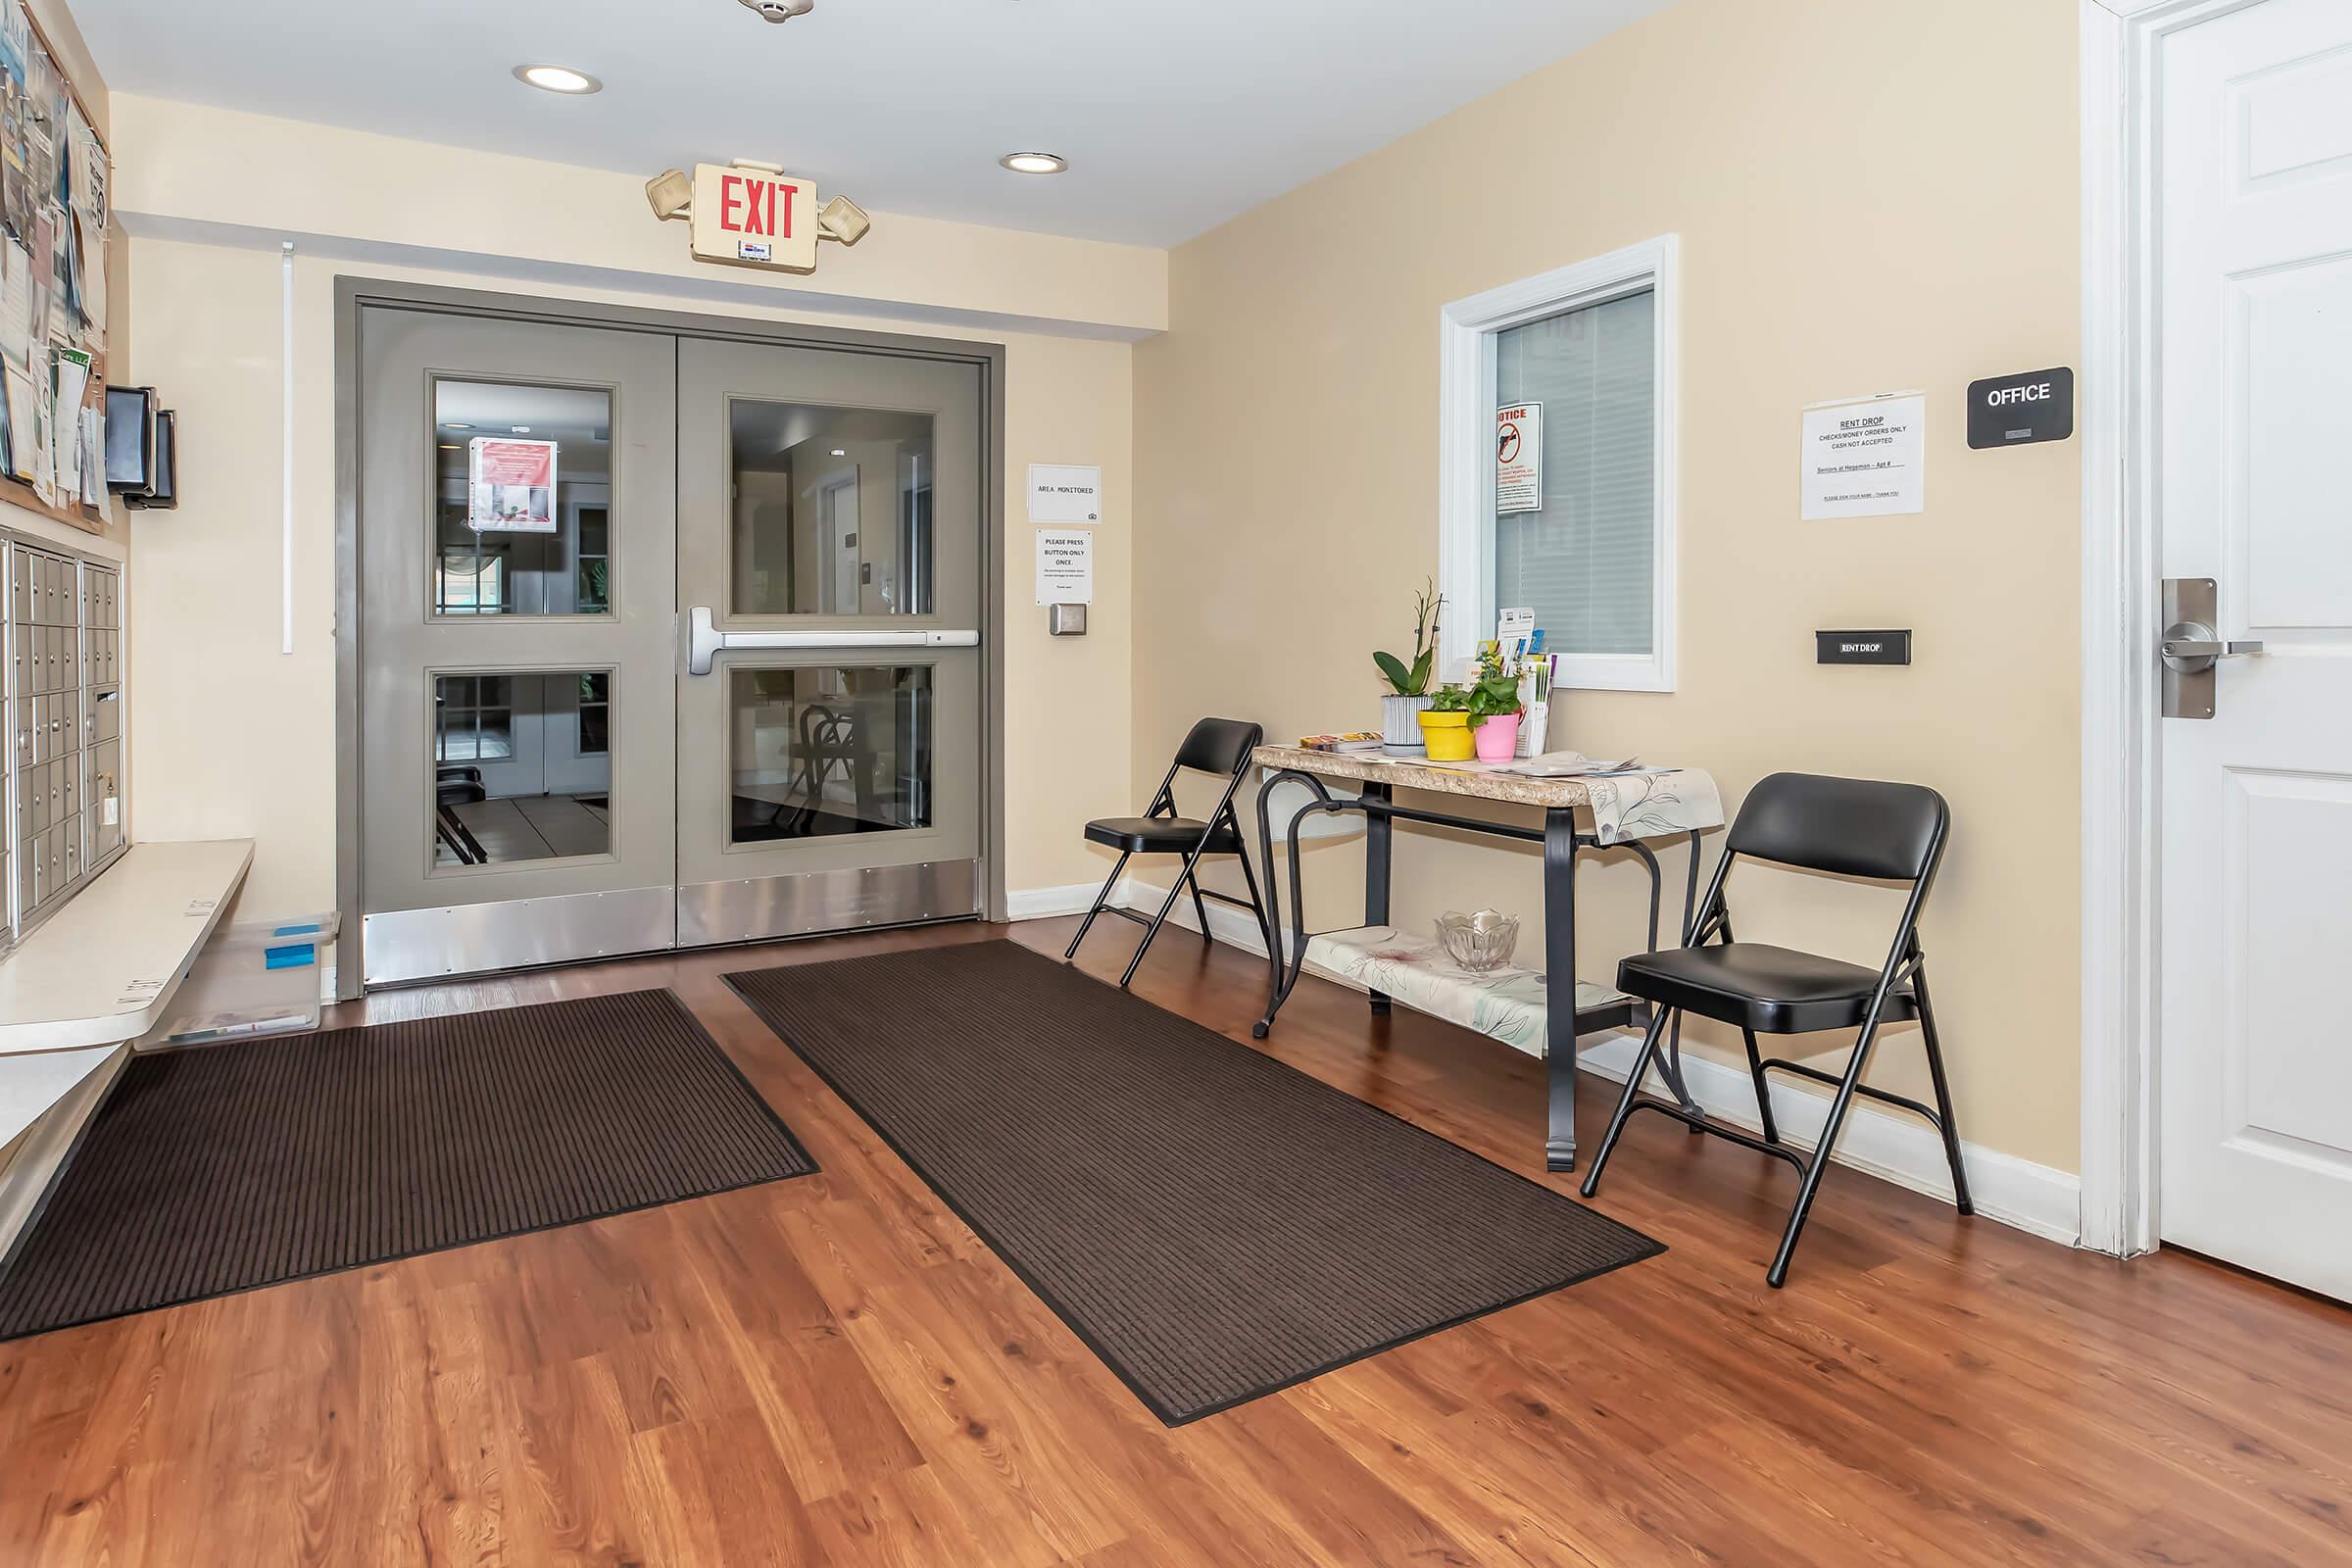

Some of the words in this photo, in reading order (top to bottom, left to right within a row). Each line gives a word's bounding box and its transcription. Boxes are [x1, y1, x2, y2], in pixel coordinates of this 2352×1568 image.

[721, 174, 798, 238] EXIT
[1987, 382, 2050, 406] OFFICE
[1840, 418, 1860, 428] RENT
[1862, 416, 1884, 426] DROP
[1864, 427, 1889, 436] ORDERS
[1861, 437, 1893, 446] ACCEPTED
[1842, 643, 1860, 652] RENT
[1860, 643, 1880, 652] DROP
